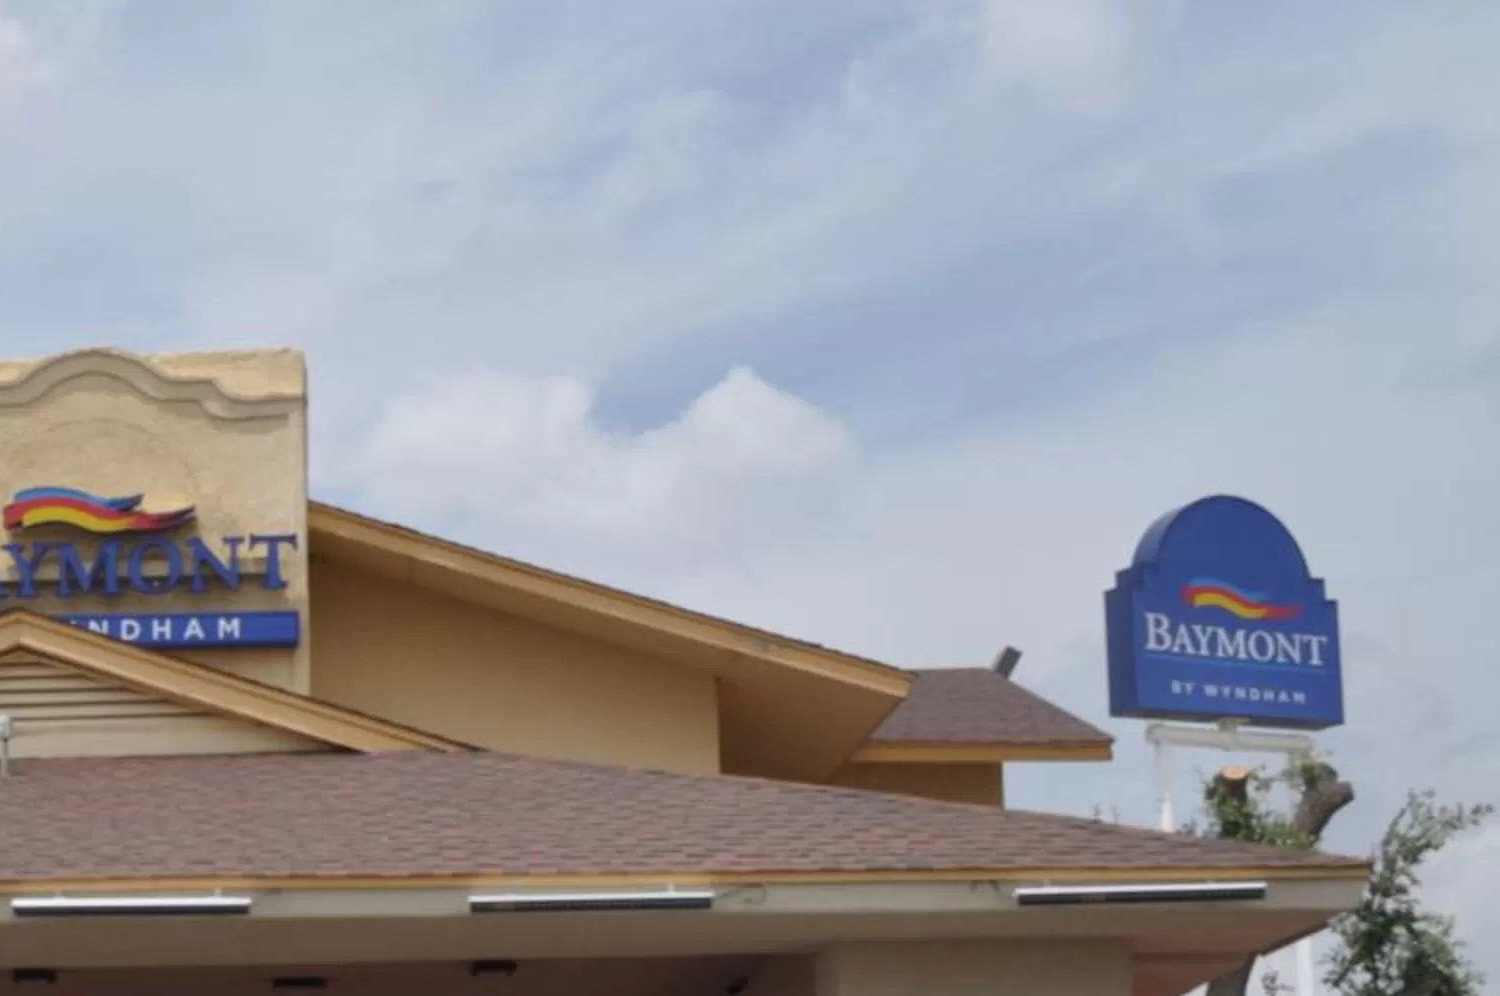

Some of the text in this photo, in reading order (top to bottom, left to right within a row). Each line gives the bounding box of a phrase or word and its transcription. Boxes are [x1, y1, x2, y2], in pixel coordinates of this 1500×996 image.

[70, 617, 241, 641] NDHAM
[1143, 612, 1327, 666] BAYMONT
[1171, 680, 1305, 703] BY WYNDHAM
